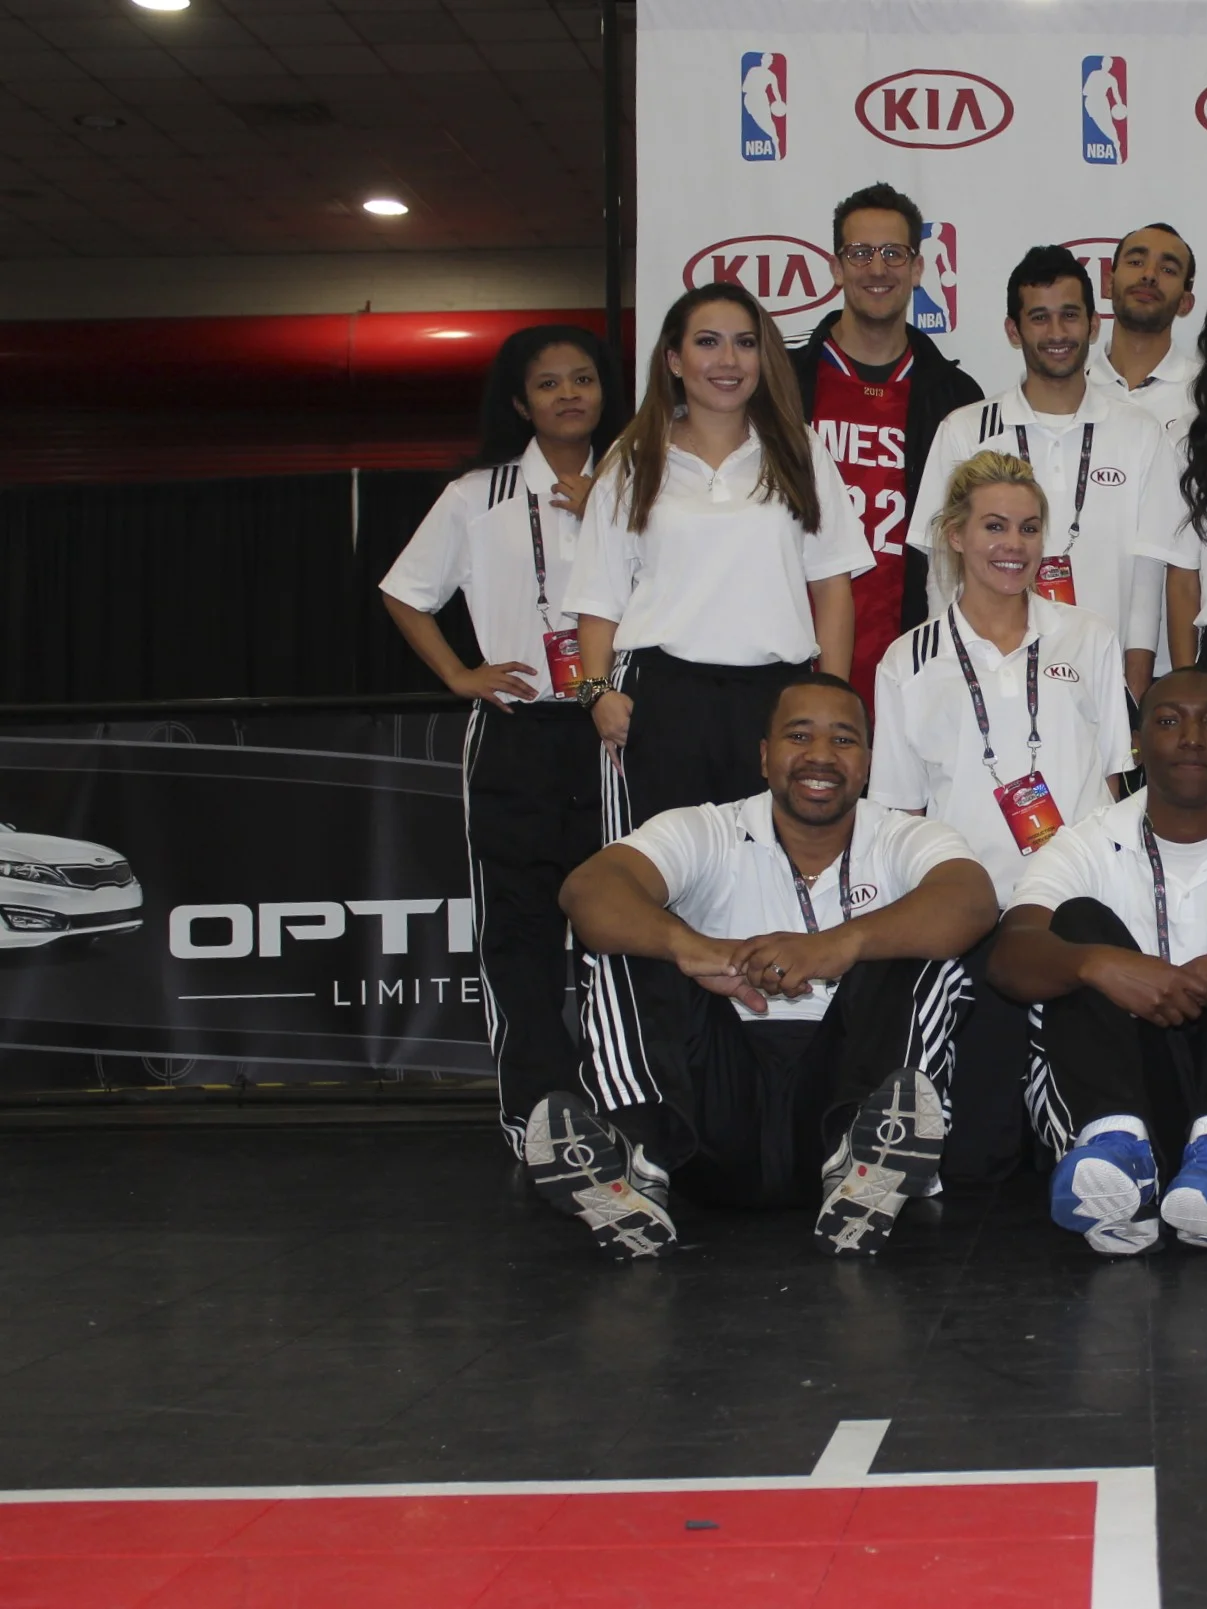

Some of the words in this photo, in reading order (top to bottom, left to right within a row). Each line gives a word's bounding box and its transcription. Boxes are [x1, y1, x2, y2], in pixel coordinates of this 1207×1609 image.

[881, 88, 987, 131] KIA
[745, 140, 773, 156] NBA
[1086, 143, 1114, 159] NBA
[711, 254, 818, 298] KIA
[917, 312, 944, 329] NBA
[864, 386, 884, 398] 2013
[1097, 471, 1121, 482] KIA
[568, 664, 578, 678] 1
[1050, 666, 1076, 680] KIA
[1028, 814, 1041, 828] 1
[169, 898, 473, 959] OPTI
[333, 977, 481, 1006] LIMITE
